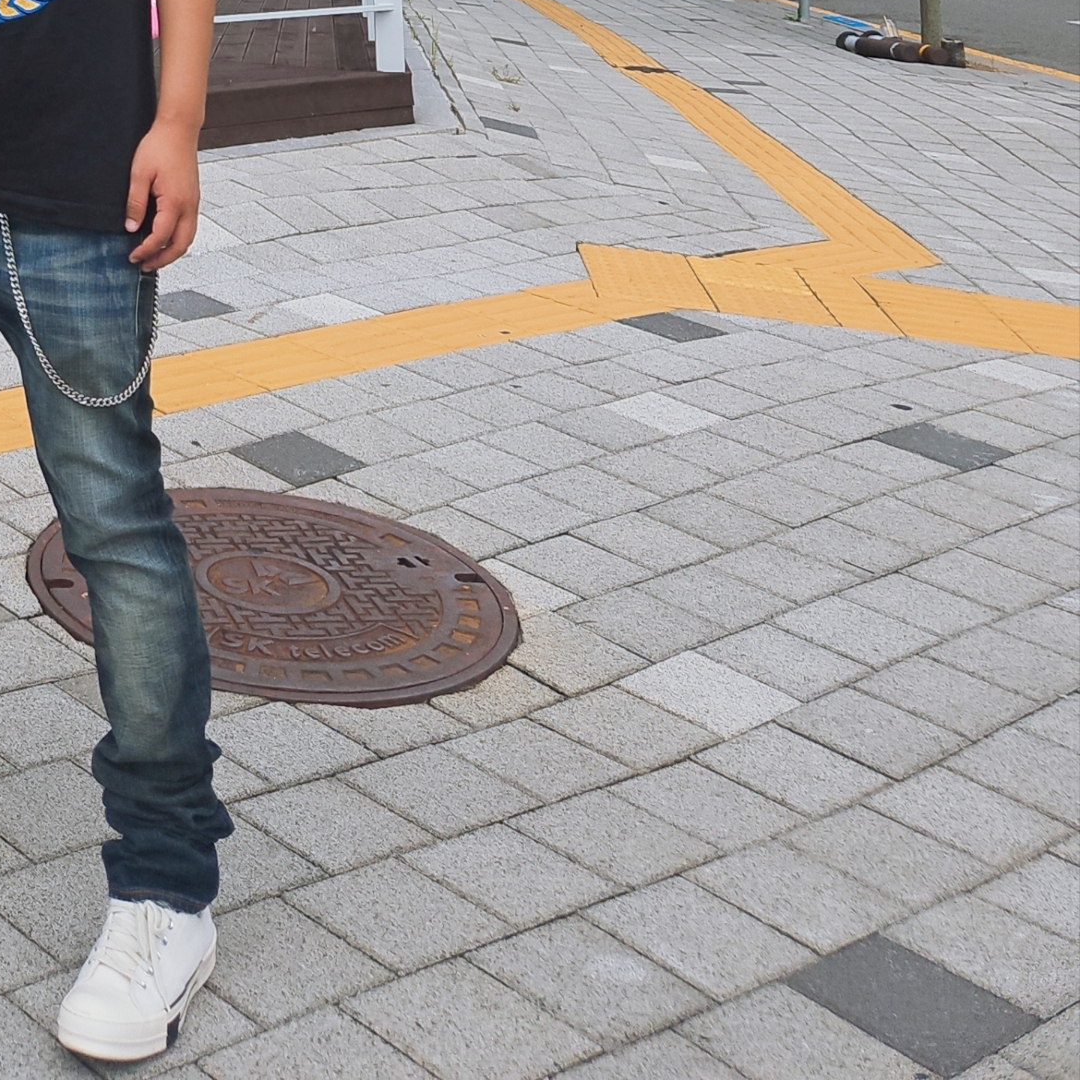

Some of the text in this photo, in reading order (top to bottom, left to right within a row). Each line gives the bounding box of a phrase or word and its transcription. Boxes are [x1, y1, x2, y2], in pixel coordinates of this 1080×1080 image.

[220, 574, 282, 598] SK
[220, 631, 407, 659] SK telecom
